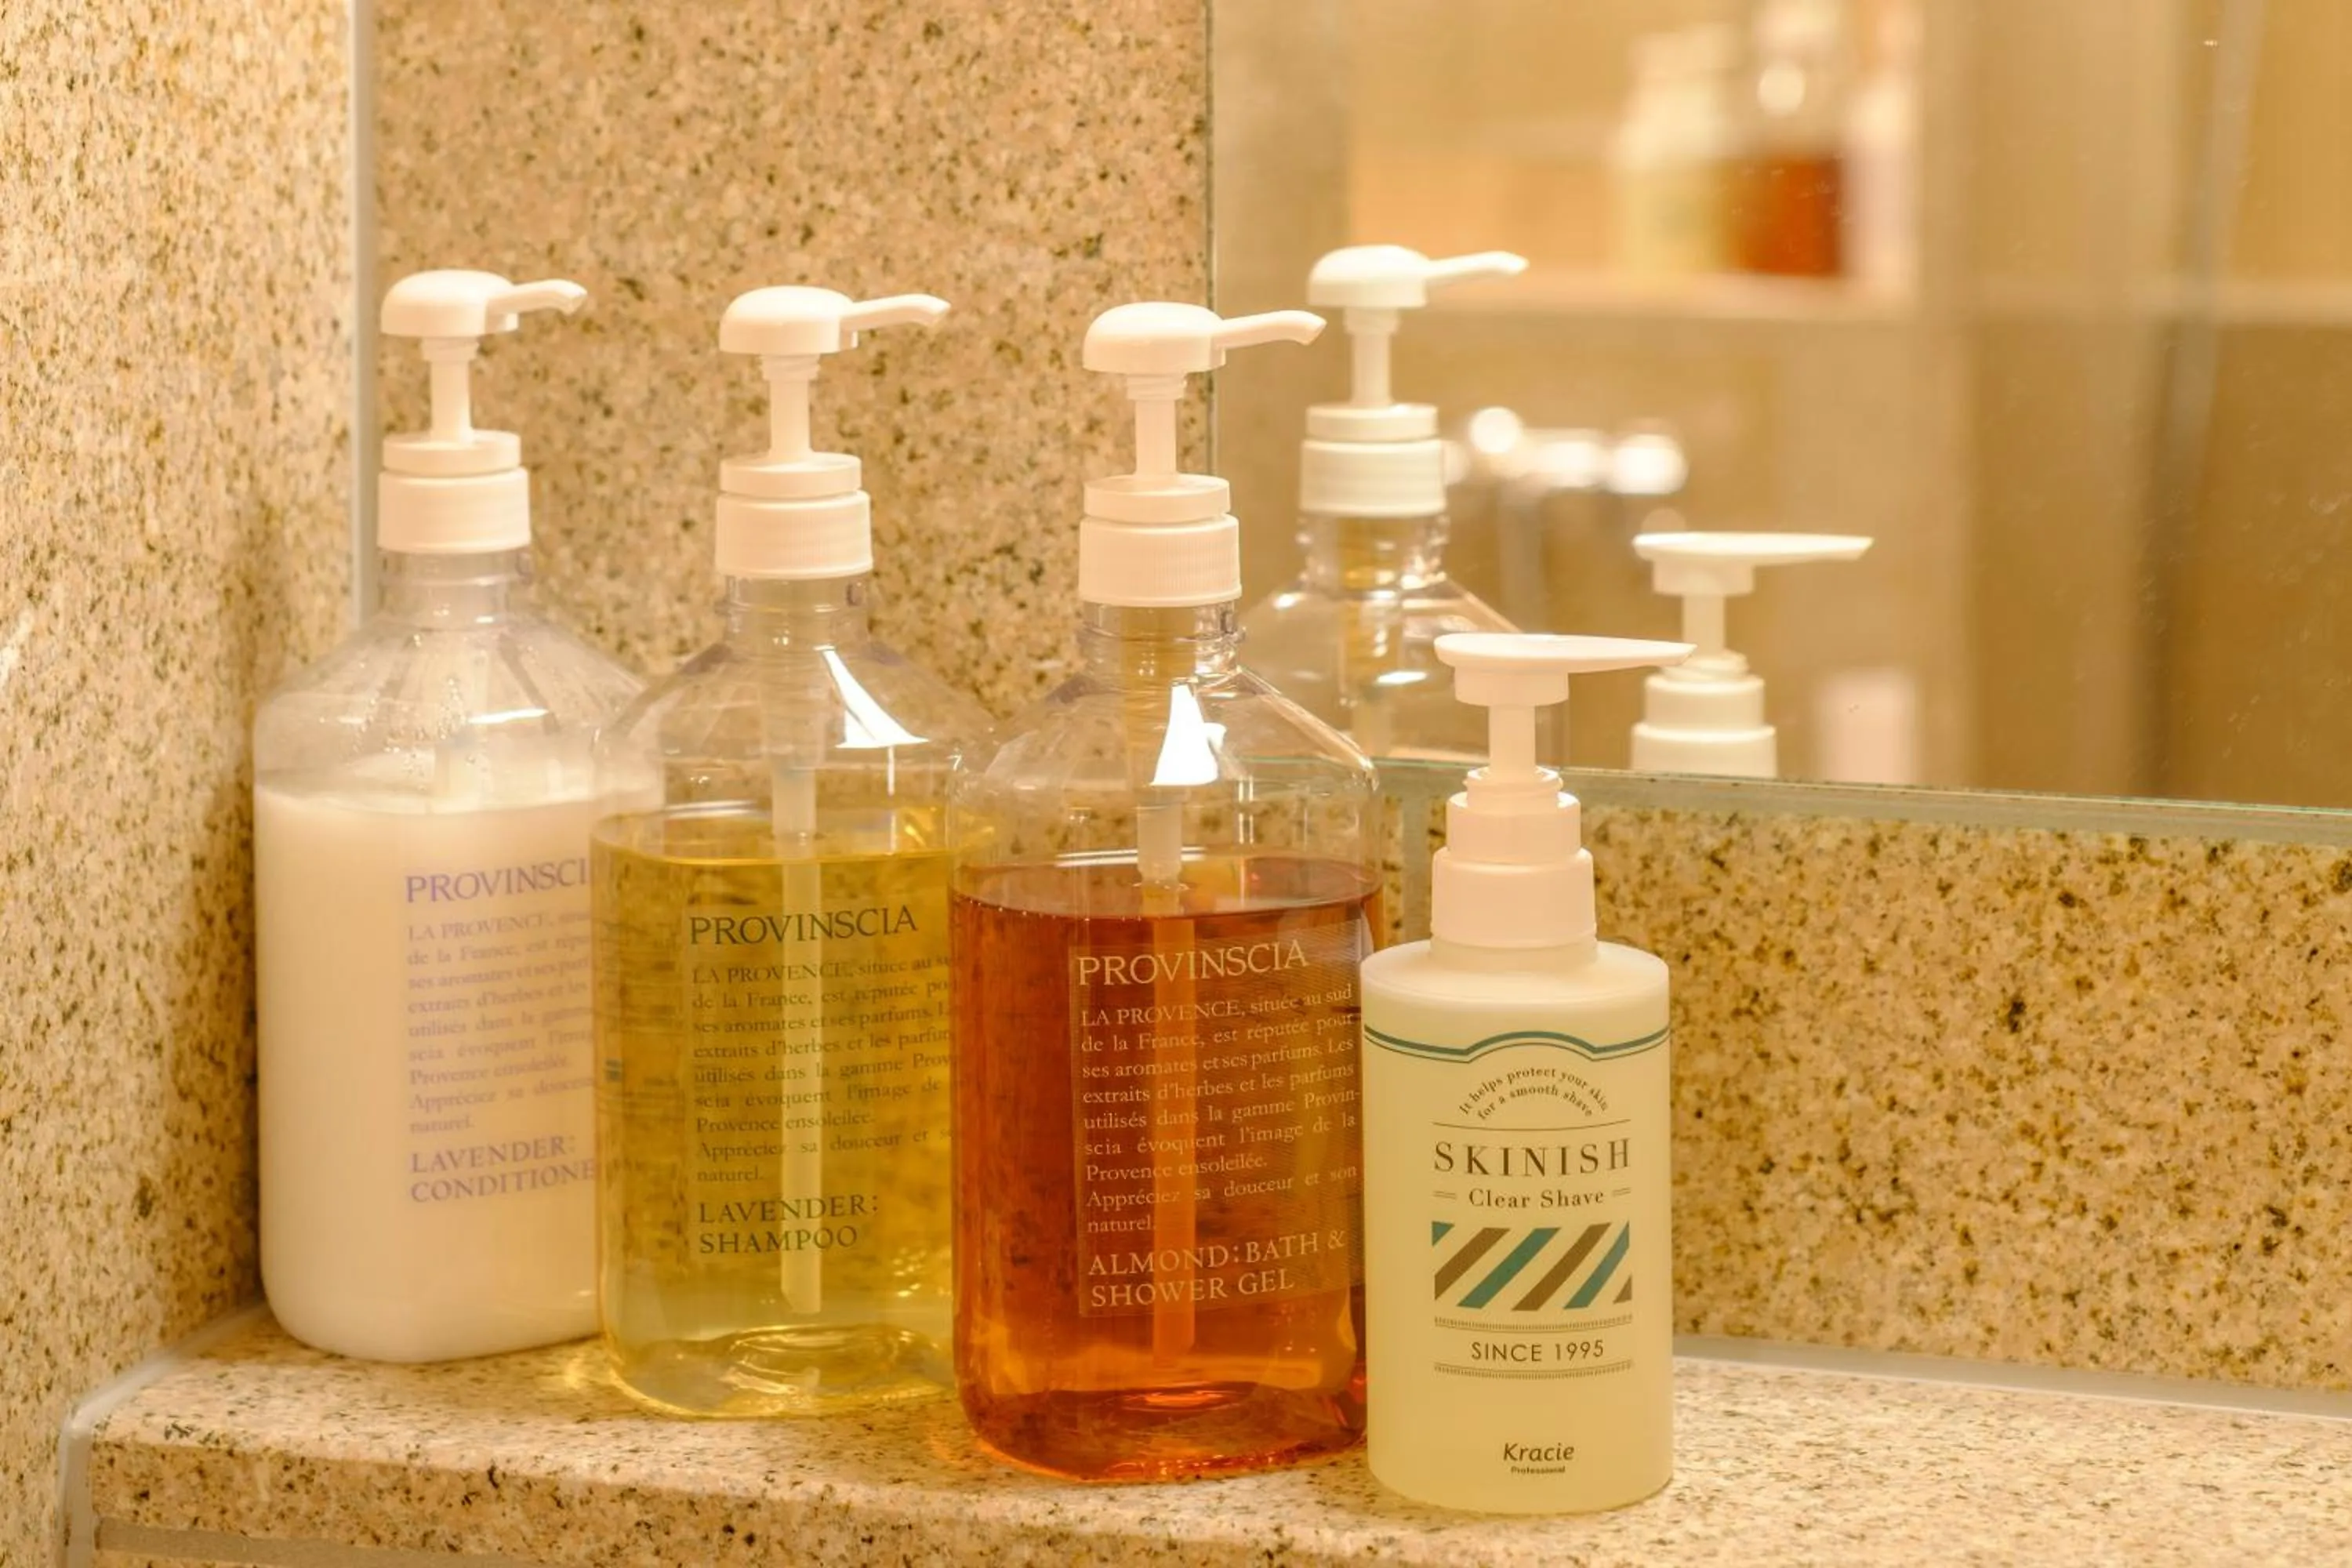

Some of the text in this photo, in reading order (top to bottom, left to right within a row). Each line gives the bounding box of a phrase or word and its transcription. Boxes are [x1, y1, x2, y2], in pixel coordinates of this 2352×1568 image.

[405, 858, 586, 903] PROVINSCI
[690, 905, 918, 945] PROVINSCIA
[692, 966, 720, 984] LA
[1076, 939, 1310, 985] PROVINSCIA
[692, 993, 714, 1009] de
[722, 992, 739, 1008] la
[1081, 1008, 1110, 1027] LA
[1116, 1001, 1246, 1025] PROVENCE,
[1303, 993, 1323, 1007] au
[1325, 983, 1353, 1004] sud
[725, 1017, 805, 1033] aromates
[1081, 1036, 1104, 1053] de
[1113, 1034, 1128, 1051] la
[1138, 1033, 1205, 1051] France,
[1214, 1030, 1239, 1044] est
[1316, 1013, 1355, 1036] pour
[694, 1044, 758, 1058] extraits
[765, 1038, 840, 1058] d'herbes
[847, 1039, 864, 1051] et
[1082, 1065, 1109, 1079] ses
[1115, 1060, 1197, 1079] aromates
[1203, 1057, 1219, 1071] et
[1221, 1054, 1247, 1068] ses
[1328, 1036, 1354, 1055] Les
[764, 1065, 806, 1081] dans
[840, 1061, 903, 1080] gamme
[913, 1052, 950, 1069] Prov
[1083, 1063, 1355, 1104] extraits d'herbes et les parfums
[1459, 1066, 1608, 1116] It helps protect your skin
[1084, 1088, 1361, 1129] utilisés dans la gamme Provin-
[1477, 1084, 1594, 1121] for a smooth shave
[697, 1116, 779, 1134] Provence
[1085, 1111, 1356, 1156] scia évoquent l'image de la
[411, 1135, 576, 1174] LAVENDER:
[829, 1133, 902, 1152] douceur
[1434, 1138, 1631, 1178] SKINISH
[410, 1158, 595, 1203] CONDITIONE
[1087, 1164, 1173, 1181] Provence
[1087, 1166, 1357, 1212] Appréciez sa douceur et son
[699, 1194, 878, 1224] LAVENDER:
[1468, 1187, 1605, 1209] Clear Shave
[699, 1225, 858, 1254] SHAMPOO
[1087, 1217, 1156, 1234] naturel.
[1327, 1229, 1346, 1250] &
[1091, 1269, 1295, 1308] SHOWER GEL
[1471, 1339, 1605, 1363] SINCE 1995
[1502, 1442, 1575, 1463] Kracie
[1510, 1465, 1566, 1475] Professional
